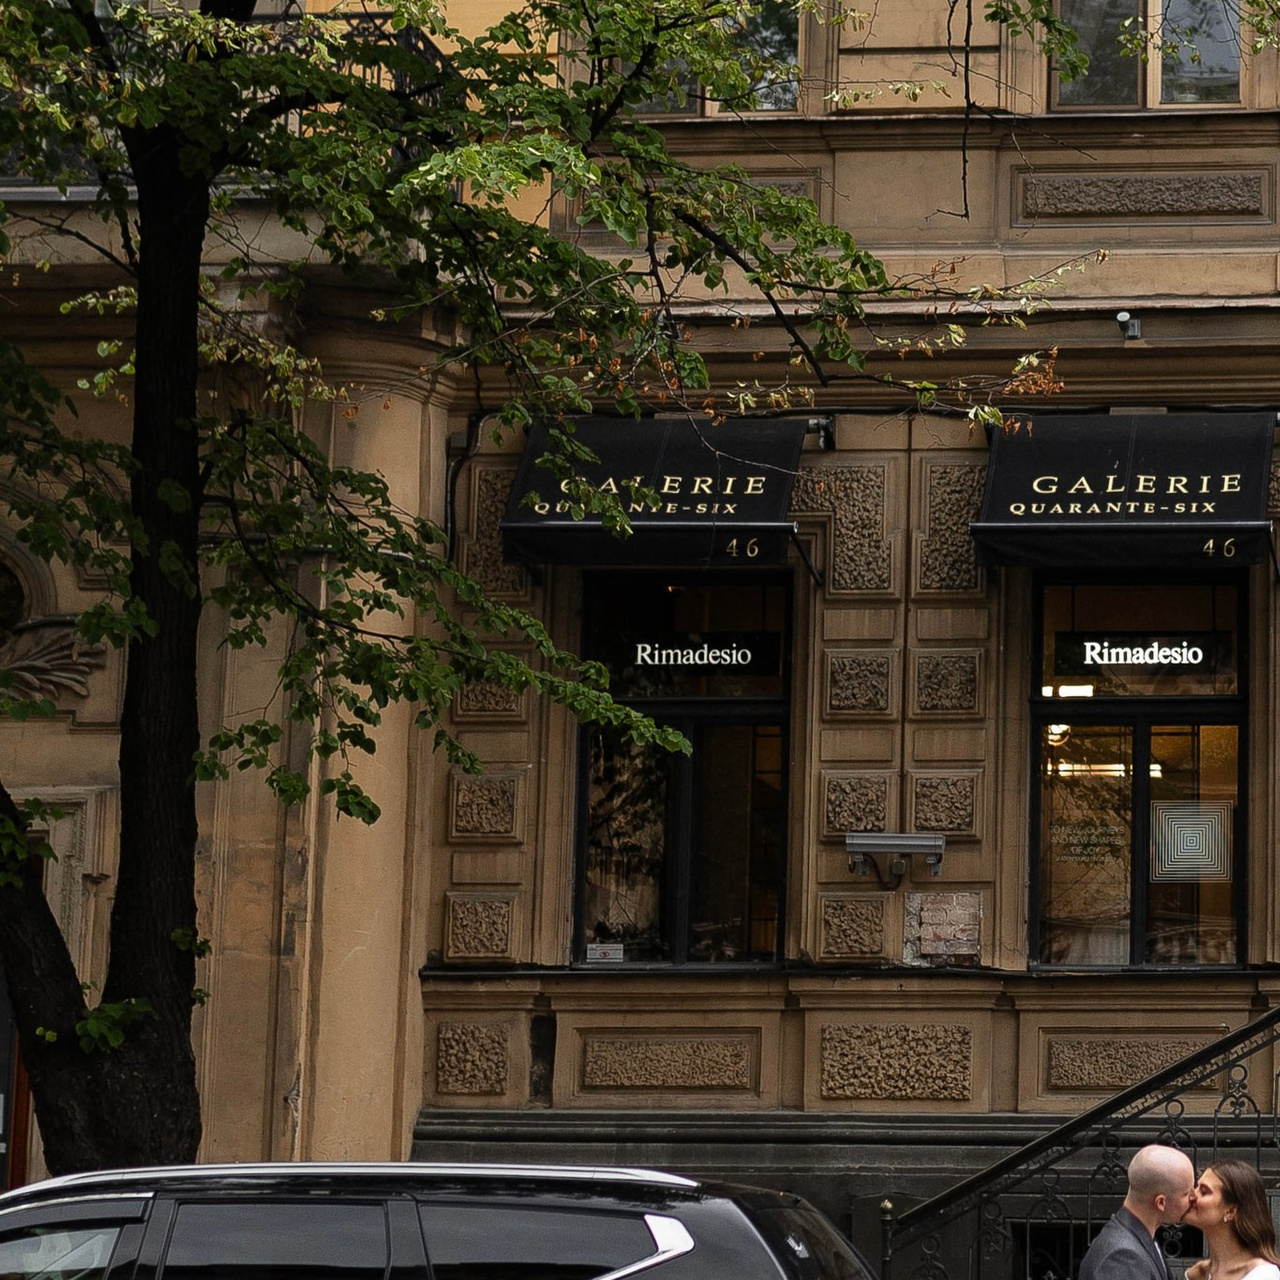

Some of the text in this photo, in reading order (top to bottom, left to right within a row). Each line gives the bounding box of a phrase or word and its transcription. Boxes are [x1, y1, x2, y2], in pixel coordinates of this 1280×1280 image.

[1031, 473, 1242, 494] GALERIE
[533, 501, 739, 516] QUNE-SIX
[1009, 501, 1217, 516] QUARANTE-SIX
[725, 538, 759, 558] 46
[1202, 537, 1236, 558] 46
[634, 642, 752, 665] Rimadesio
[1083, 640, 1204, 665] Rimadesio
